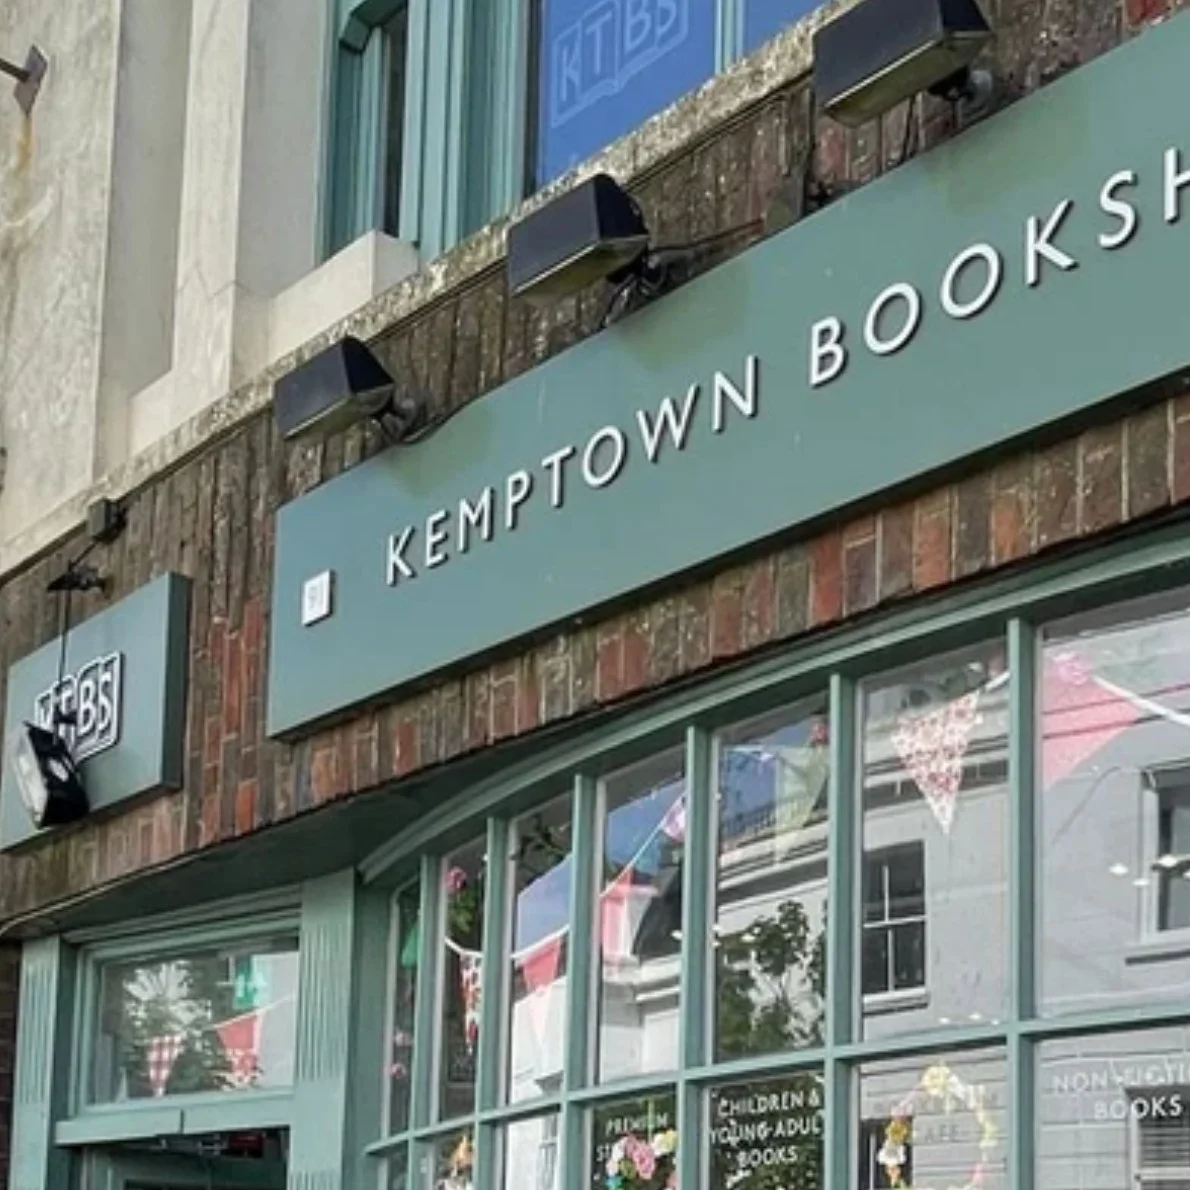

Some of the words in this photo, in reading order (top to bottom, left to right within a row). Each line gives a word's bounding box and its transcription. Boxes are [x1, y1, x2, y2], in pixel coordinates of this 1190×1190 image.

[385, 355, 758, 586] KEMPTOWN
[718, 1090, 804, 1118] CHILDREN
[1093, 1094, 1184, 1121] BOOKS
[709, 1119, 771, 1145] YOUNG
[737, 1145, 798, 1168] BOOKS
